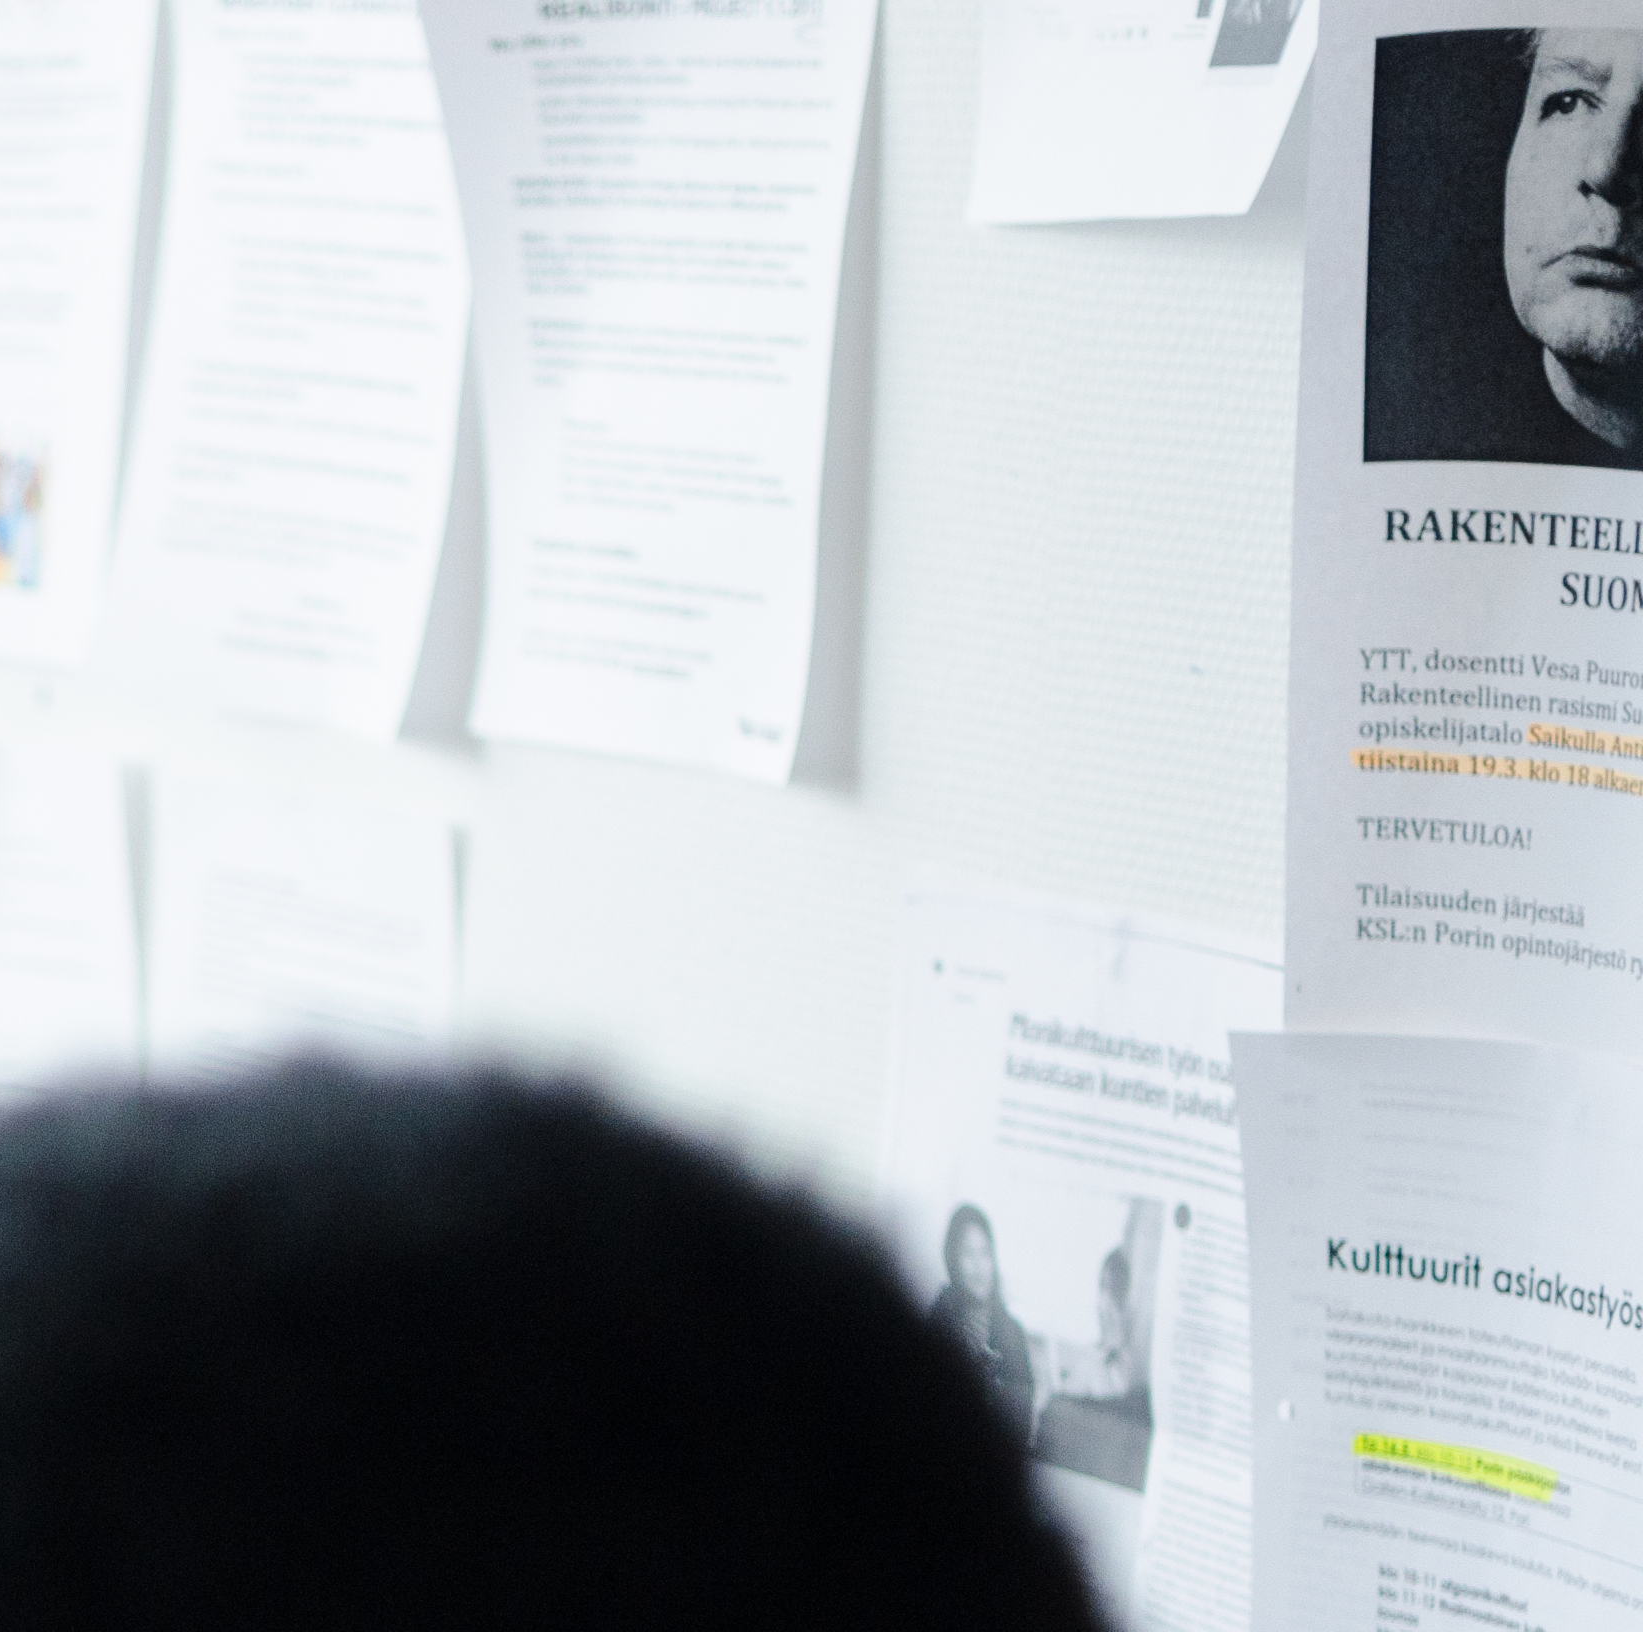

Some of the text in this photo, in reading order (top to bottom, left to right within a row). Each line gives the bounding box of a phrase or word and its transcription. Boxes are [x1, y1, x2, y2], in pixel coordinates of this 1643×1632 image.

[1360, 648, 1643, 691] YTT, dosentti Vesa Puuro
[1360, 682, 1542, 713] Rakenteellinen
[1548, 694, 1617, 723] rasismi
[1359, 717, 1523, 748] opiskelijatalo
[1527, 723, 1605, 757] Saikulla
[1358, 749, 1460, 776] tiistaina
[1469, 754, 1523, 780] 19.3.
[1528, 758, 1561, 785] klo
[1568, 764, 1590, 789] 18
[1357, 815, 1533, 852] TERVETULOA!
[1356, 882, 1585, 930] Tilaisuuden järjestää
[1355, 917, 1427, 945] KSL:n
[1434, 921, 1496, 951] Porin
[1501, 935, 1627, 973] opintojärjestö
[1327, 1236, 1483, 1292] Kulttuurit
